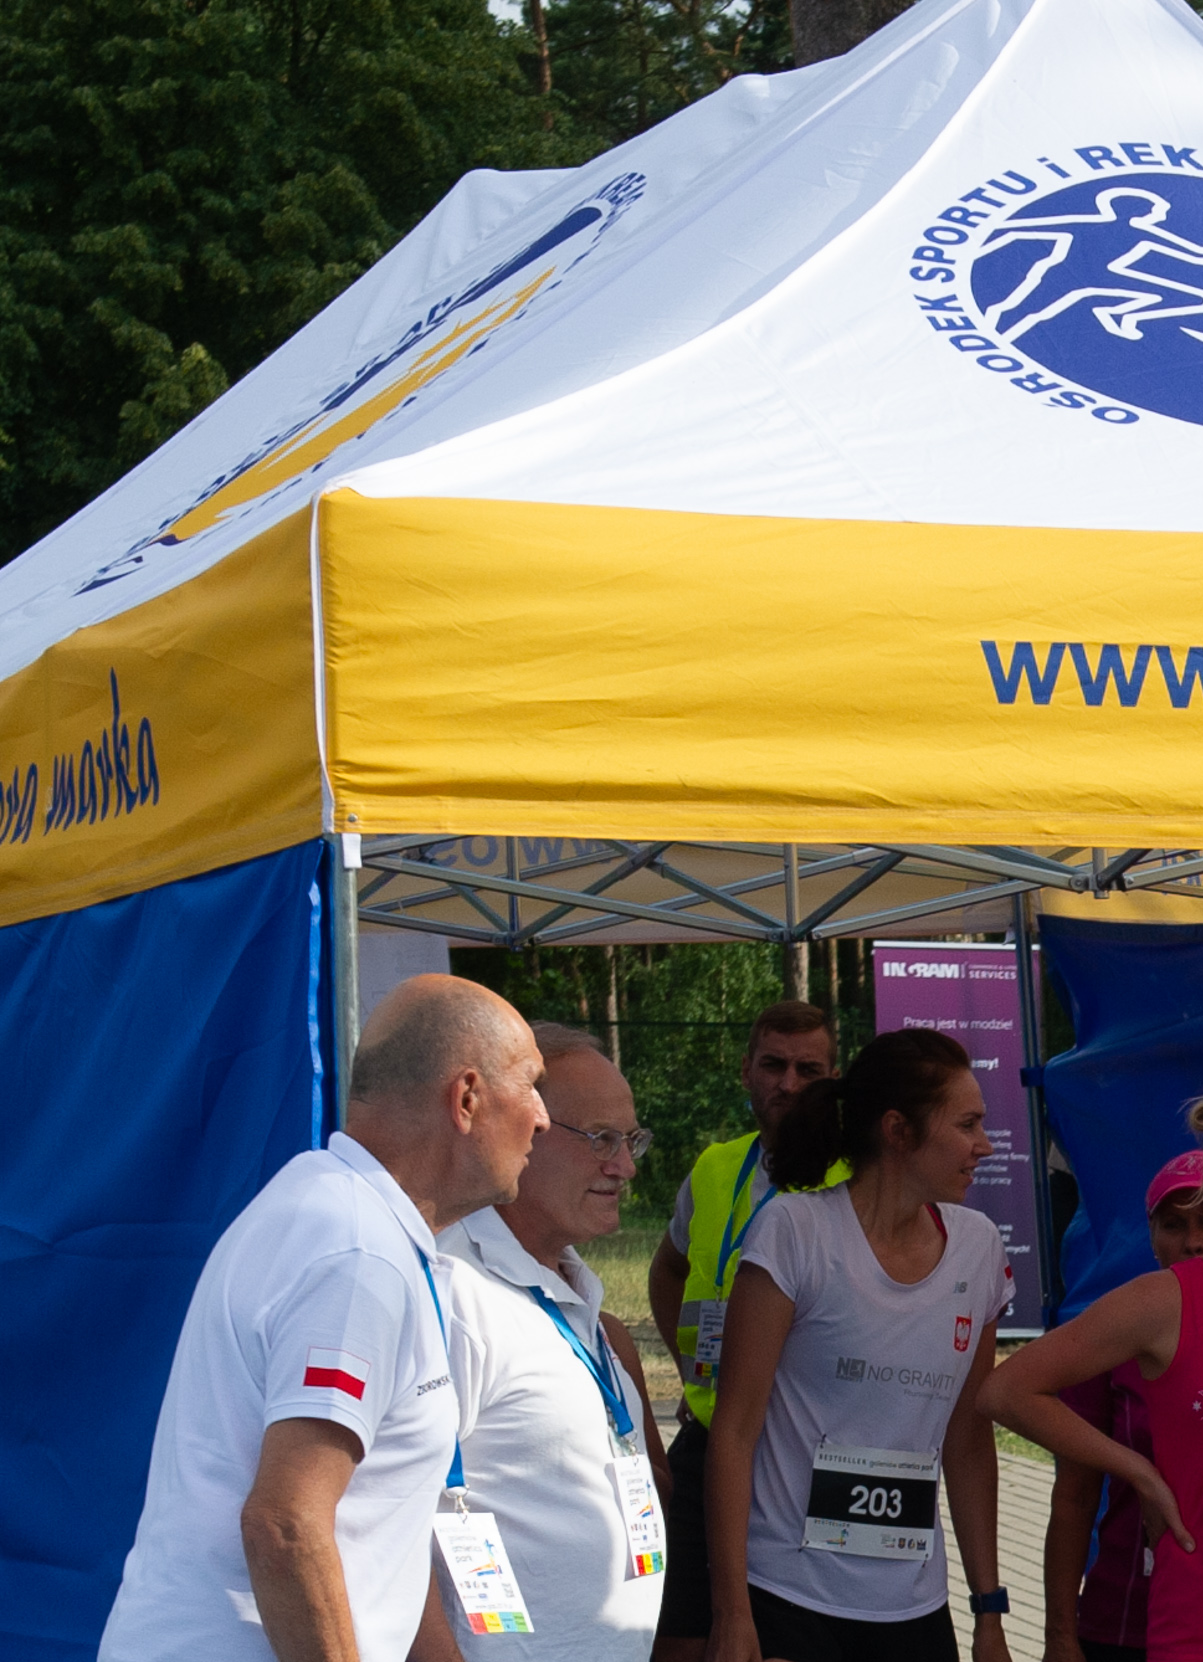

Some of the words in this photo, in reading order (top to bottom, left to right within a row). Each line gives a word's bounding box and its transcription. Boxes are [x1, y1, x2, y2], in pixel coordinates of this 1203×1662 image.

[909, 170, 1037, 283] SPORTU
[913, 294, 1140, 424] OŚRODEK
[43, 666, 160, 837] marka
[968, 970, 1017, 980] SERVICES
[903, 1016, 935, 1029] Praca
[937, 1018, 956, 1031] jest
[959, 1021, 969, 1029] w
[867, 1365, 894, 1382] NO
[819, 1453, 867, 1465] BESTSELLER
[848, 1485, 902, 1518] 203
